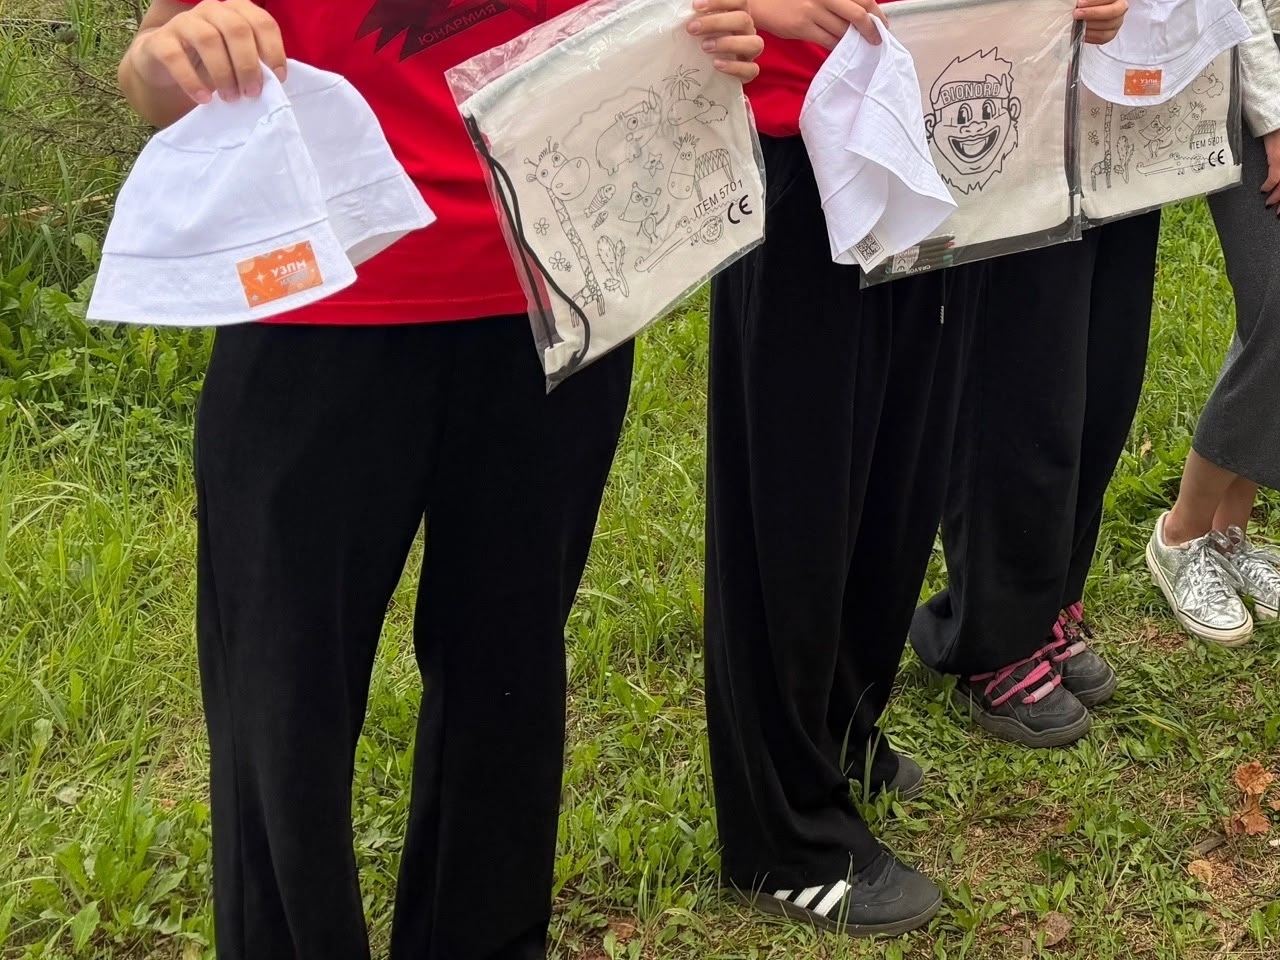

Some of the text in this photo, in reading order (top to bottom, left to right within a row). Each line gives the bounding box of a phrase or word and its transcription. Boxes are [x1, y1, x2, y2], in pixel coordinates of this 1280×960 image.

[418, 3, 497, 46] ЮНАРМИЯ
[941, 82, 1001, 105] BIONORD
[1208, 149, 1225, 167] CE
[693, 179, 743, 218] ITEM 5701
[727, 194, 753, 224] CE
[270, 259, 307, 278] УЗПМ
